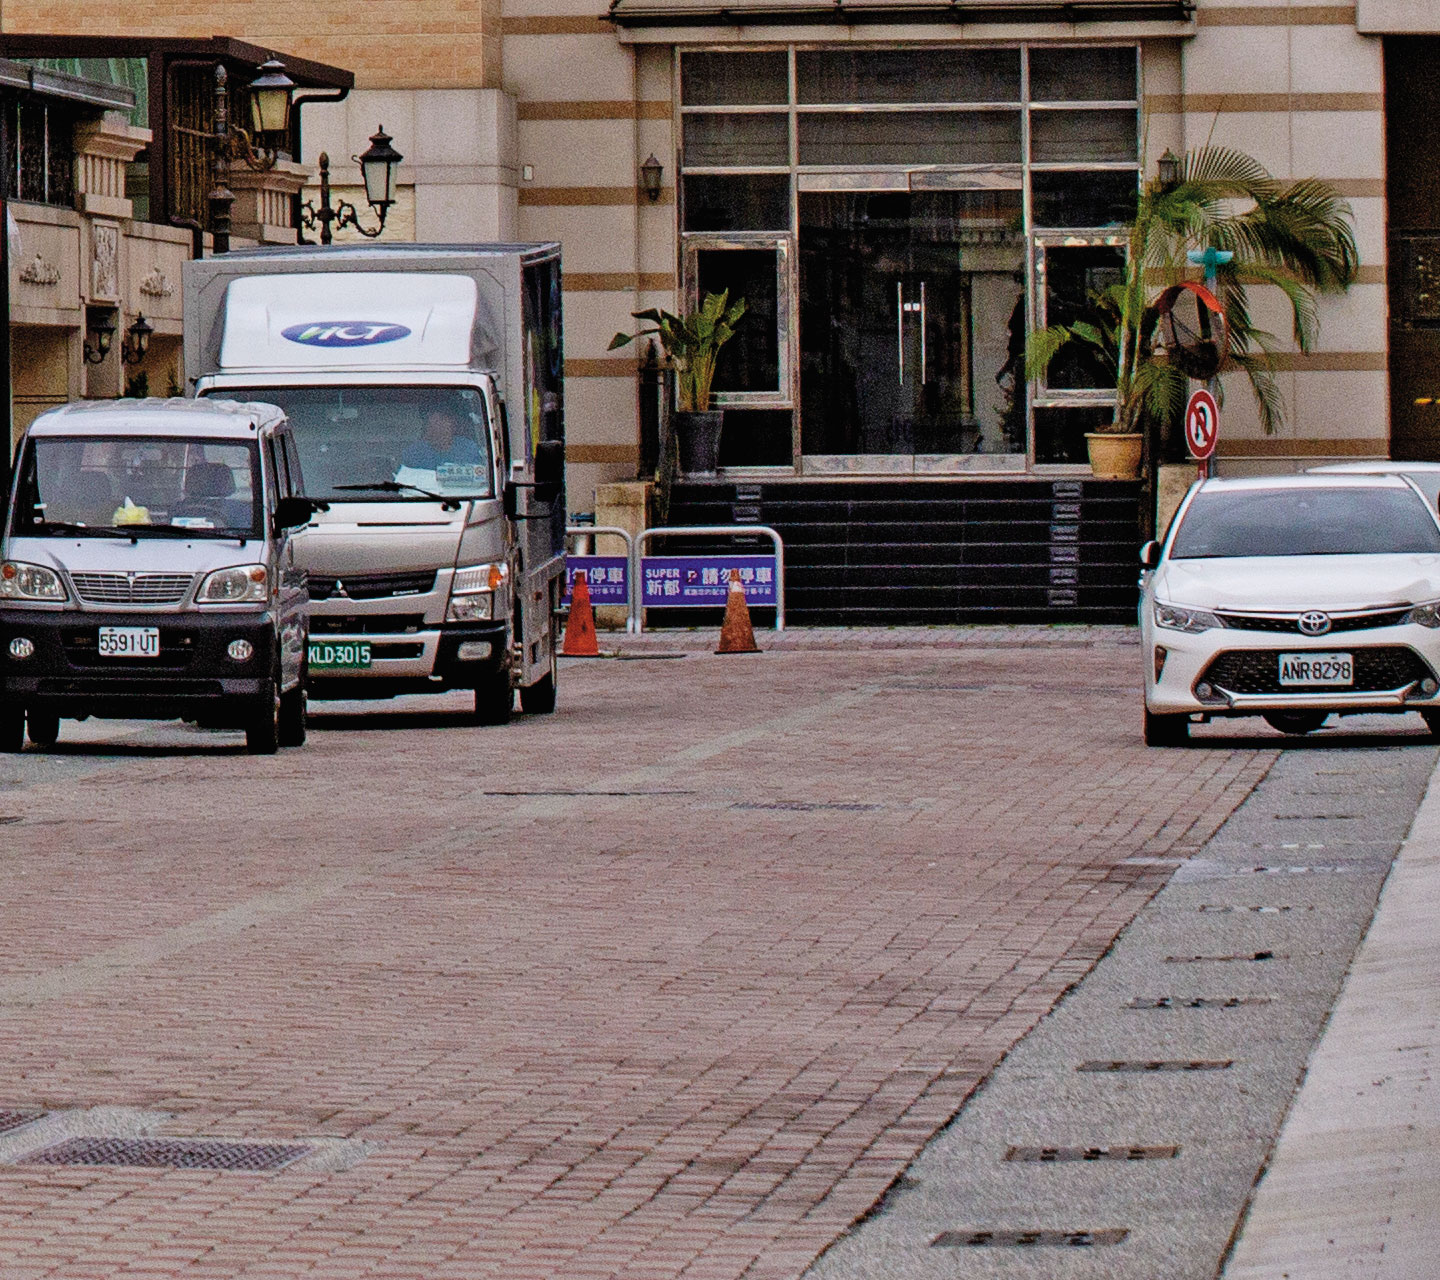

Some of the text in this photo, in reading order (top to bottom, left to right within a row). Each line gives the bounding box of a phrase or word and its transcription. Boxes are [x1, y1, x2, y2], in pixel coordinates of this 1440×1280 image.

[298, 326, 399, 340] HCT
[646, 568, 680, 578] SUPER
[646, 579, 680, 596] 新都
